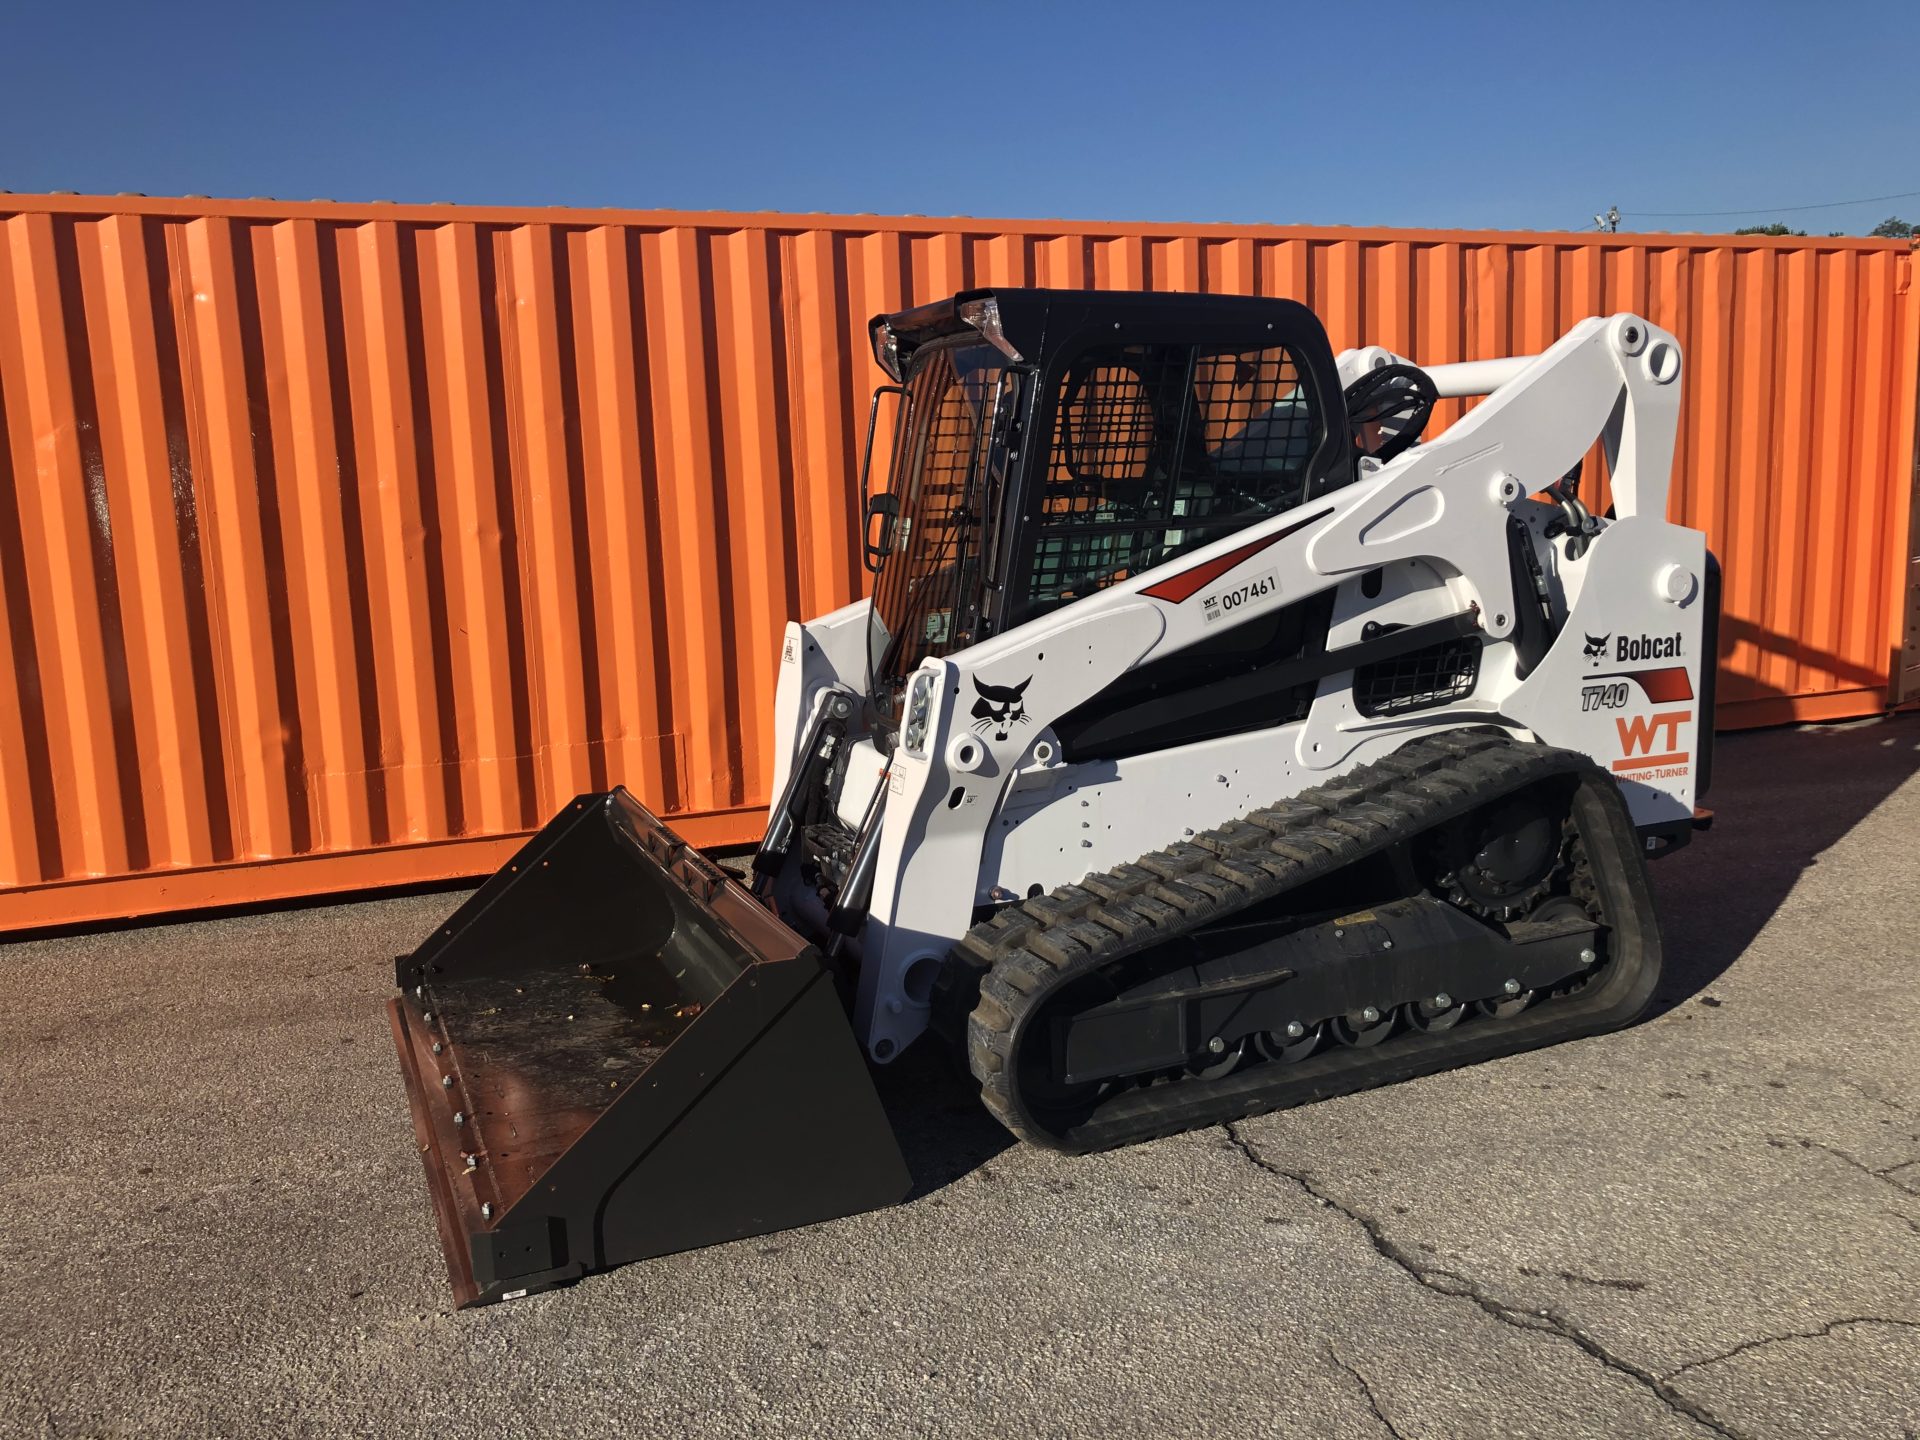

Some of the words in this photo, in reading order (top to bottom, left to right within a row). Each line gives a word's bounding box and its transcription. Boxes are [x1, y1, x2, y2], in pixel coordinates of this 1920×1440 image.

[1203, 596, 1216, 606] WT
[1222, 576, 1276, 610] 007461
[1616, 632, 1682, 662] Bobcat
[1582, 683, 1629, 712] T740
[1615, 710, 1692, 757] WT
